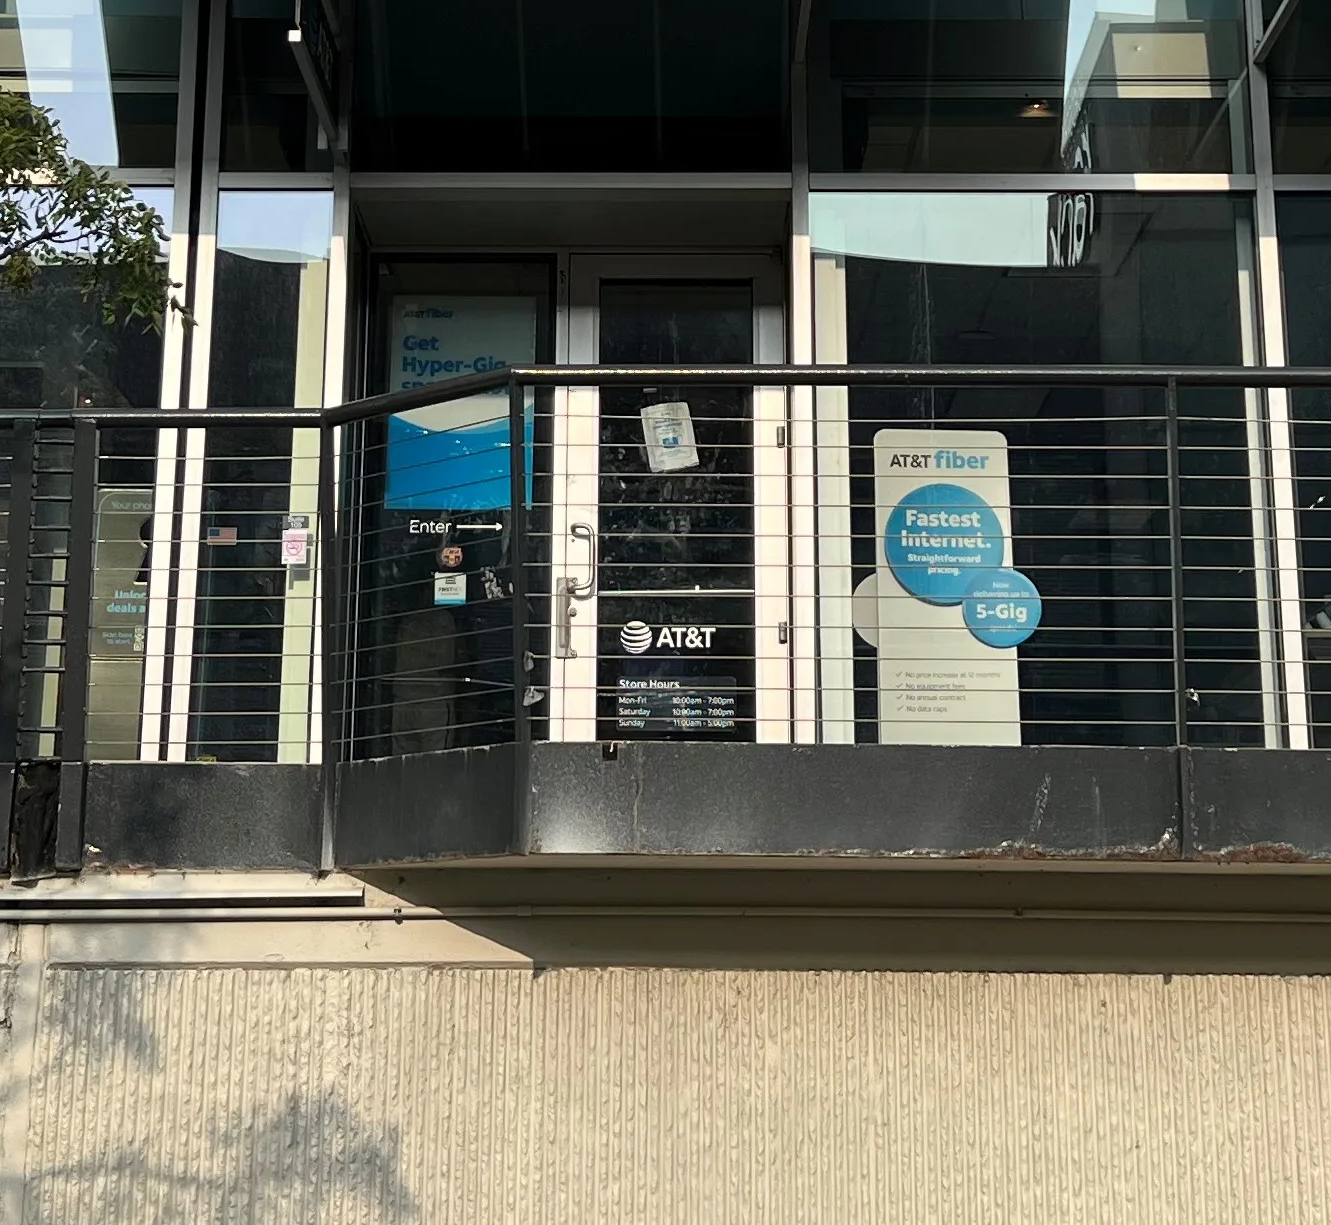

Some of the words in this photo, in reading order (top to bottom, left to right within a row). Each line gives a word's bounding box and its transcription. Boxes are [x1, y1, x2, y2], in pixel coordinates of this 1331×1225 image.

[403, 335, 439, 351] Get
[890, 454, 931, 468] AT&T
[933, 450, 989, 469] fiber
[905, 509, 981, 527] Fastest
[409, 520, 452, 534] Enter
[901, 530, 991, 548] Internet.
[907, 554, 981, 564] Straightforward
[106, 602, 137, 613] deals
[976, 602, 1028, 623] 5-Gig
[656, 627, 717, 649] AT&T
[619, 679, 648, 689] Store
[649, 679, 681, 689] Hours
[618, 708, 651, 717] Saturday
[618, 719, 646, 728] Sunday
